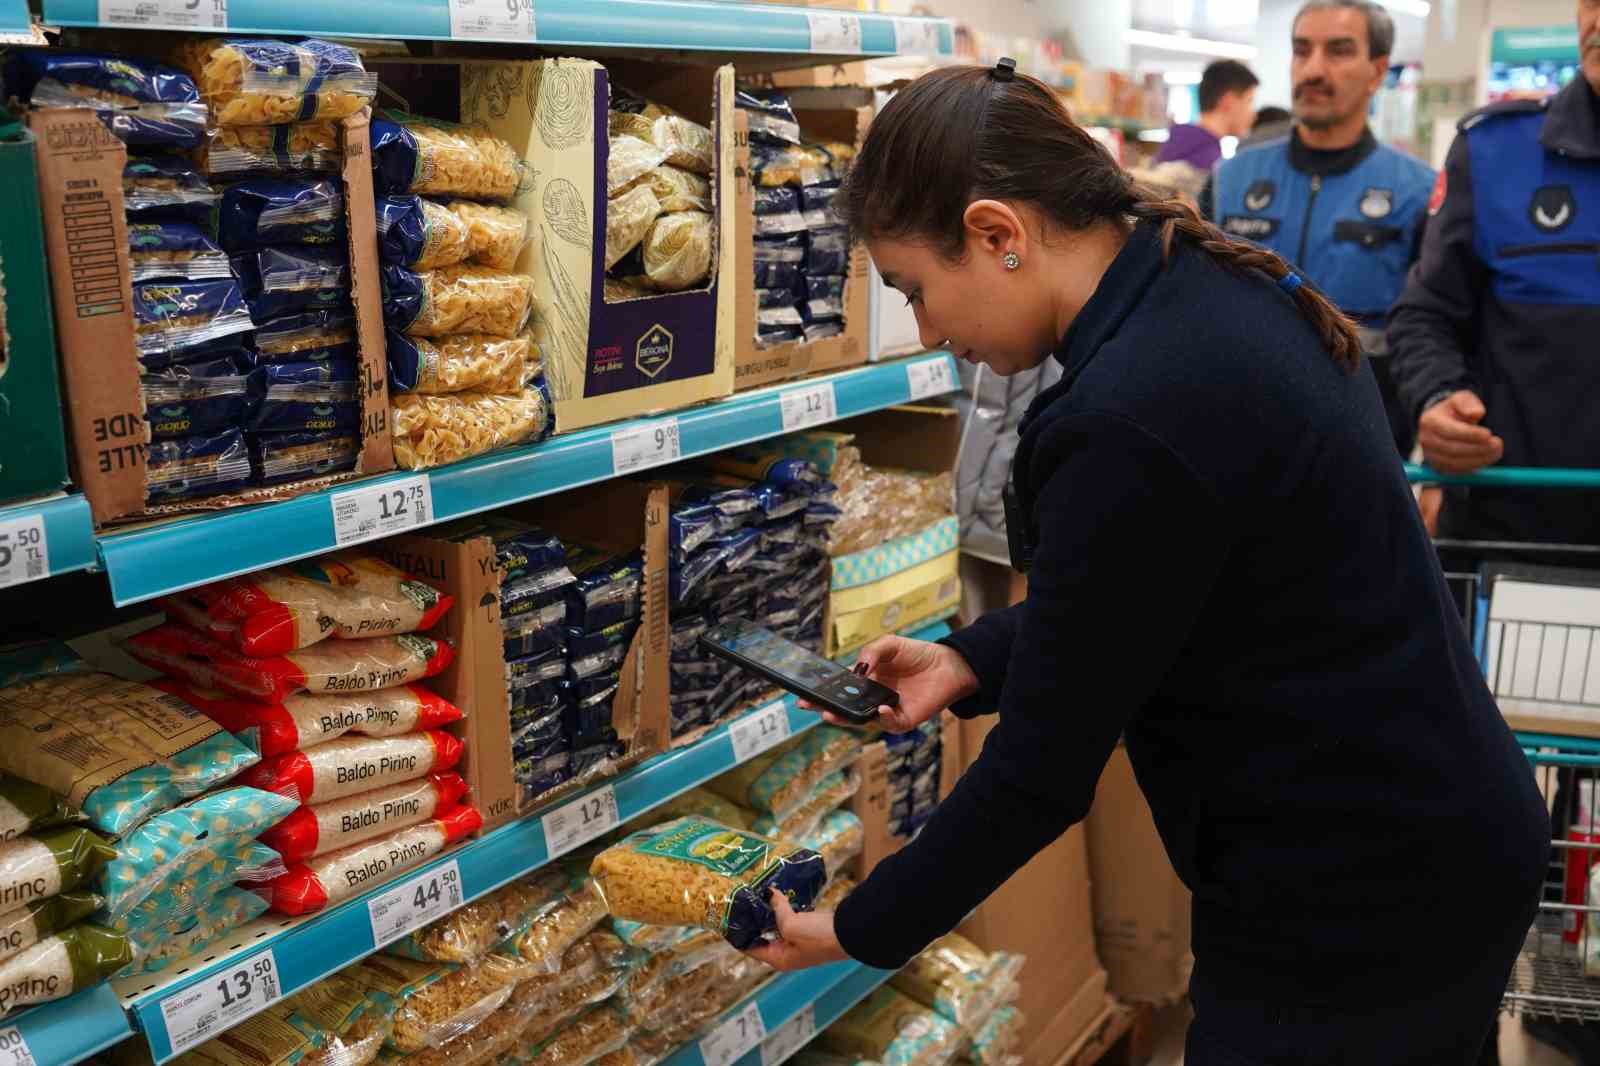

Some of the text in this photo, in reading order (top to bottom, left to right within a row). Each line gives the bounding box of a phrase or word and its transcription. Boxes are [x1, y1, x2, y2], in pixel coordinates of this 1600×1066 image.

[25, 546, 43, 561] TL
[323, 676, 366, 690] Baldo
[320, 711, 363, 733] Baldo
[336, 754, 417, 784] Baldo Pirinç
[341, 799, 419, 833] Baldo Pirinç
[345, 840, 426, 887] Baldo Pirinç
[413, 869, 457, 909] 44,50
[216, 957, 272, 1009] 13,50
[261, 974, 276, 987] TL
